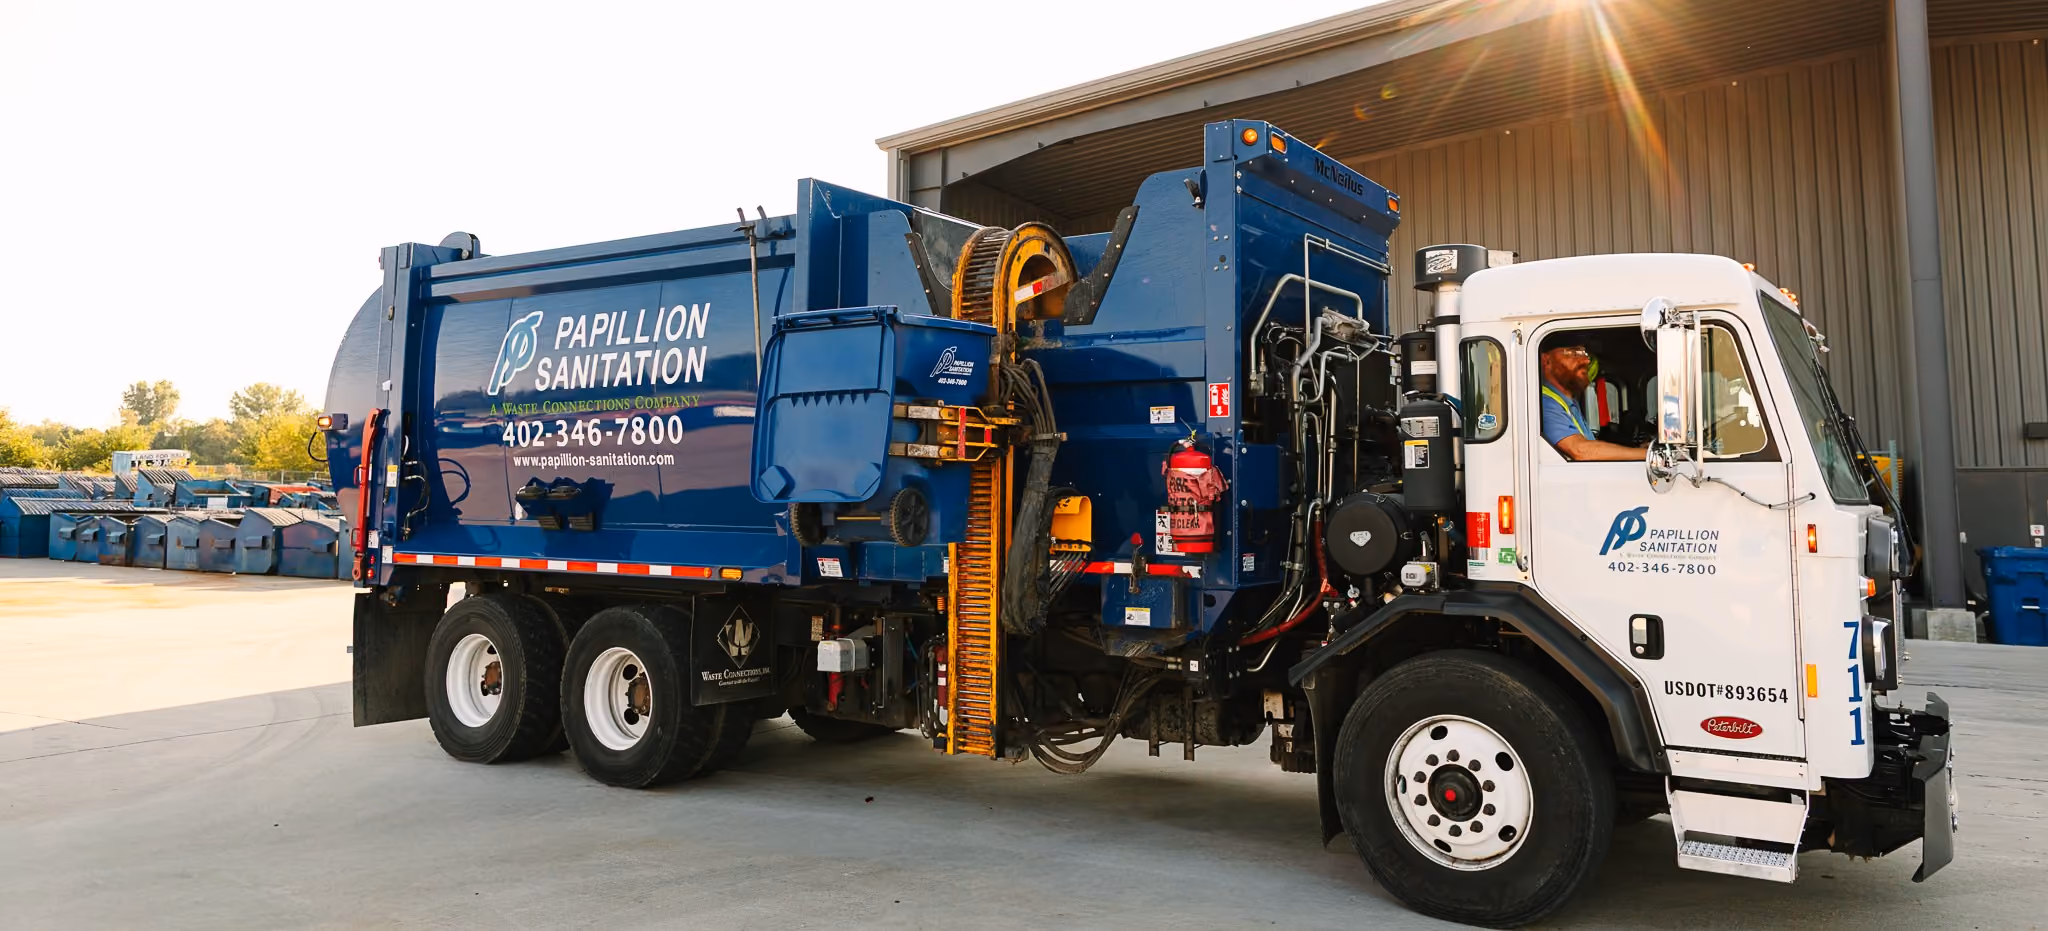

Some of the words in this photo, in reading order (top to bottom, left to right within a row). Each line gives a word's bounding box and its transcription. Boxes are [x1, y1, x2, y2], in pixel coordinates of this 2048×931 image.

[1314, 157, 1364, 196] McNeilus
[554, 303, 711, 350] PAPILLION
[534, 346, 708, 391] SANITATION
[490, 404, 497, 416] A
[502, 415, 684, 448] 402-346-7800
[513, 452, 675, 470] www.papillion-sanitation.com
[1650, 529, 1719, 541] PAPILLION
[1639, 541, 1718, 554] SANITATION
[1608, 561, 1717, 575] 402-346-7800
[1664, 680, 1789, 704] USDOT#893654
[1707, 718, 1758, 735] Peterbilt
